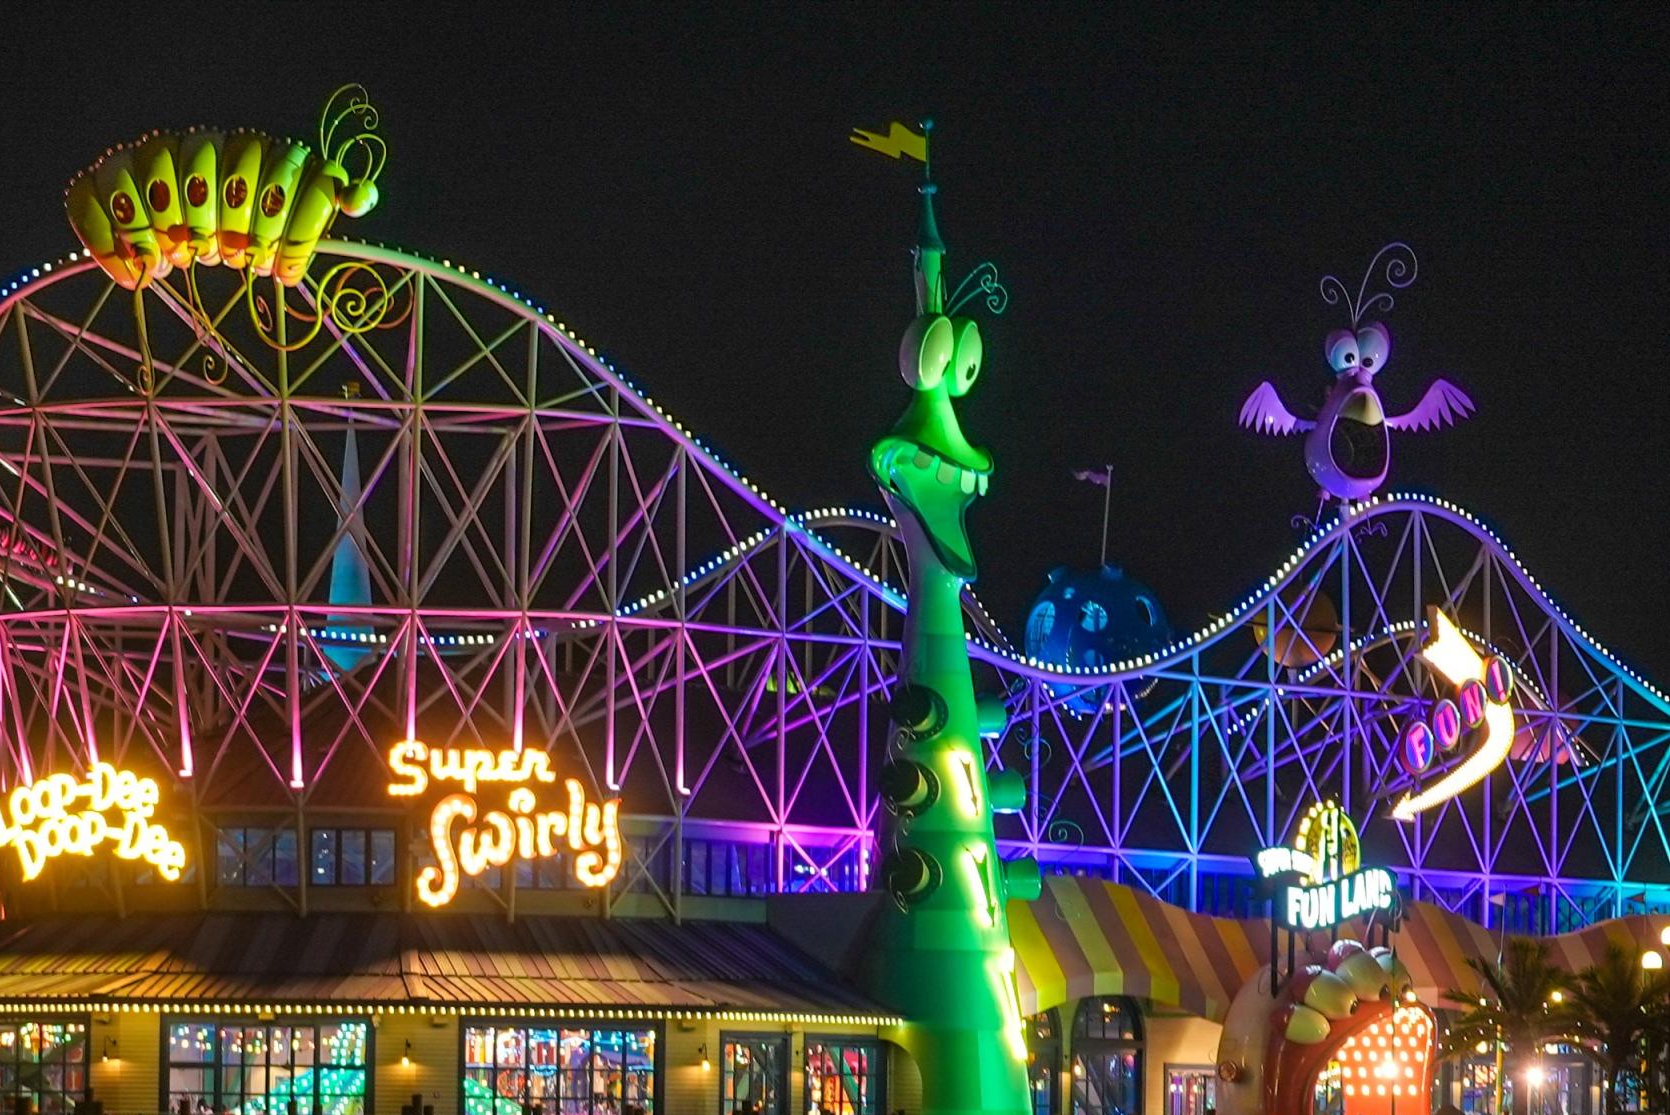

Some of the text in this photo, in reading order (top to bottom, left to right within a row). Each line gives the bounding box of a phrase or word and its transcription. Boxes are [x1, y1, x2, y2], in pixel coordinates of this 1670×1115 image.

[1408, 659, 1507, 770] FUN!
[388, 741, 556, 795] Super
[417, 779, 622, 907] Swirly
[1287, 868, 1393, 929] FUN LAND
